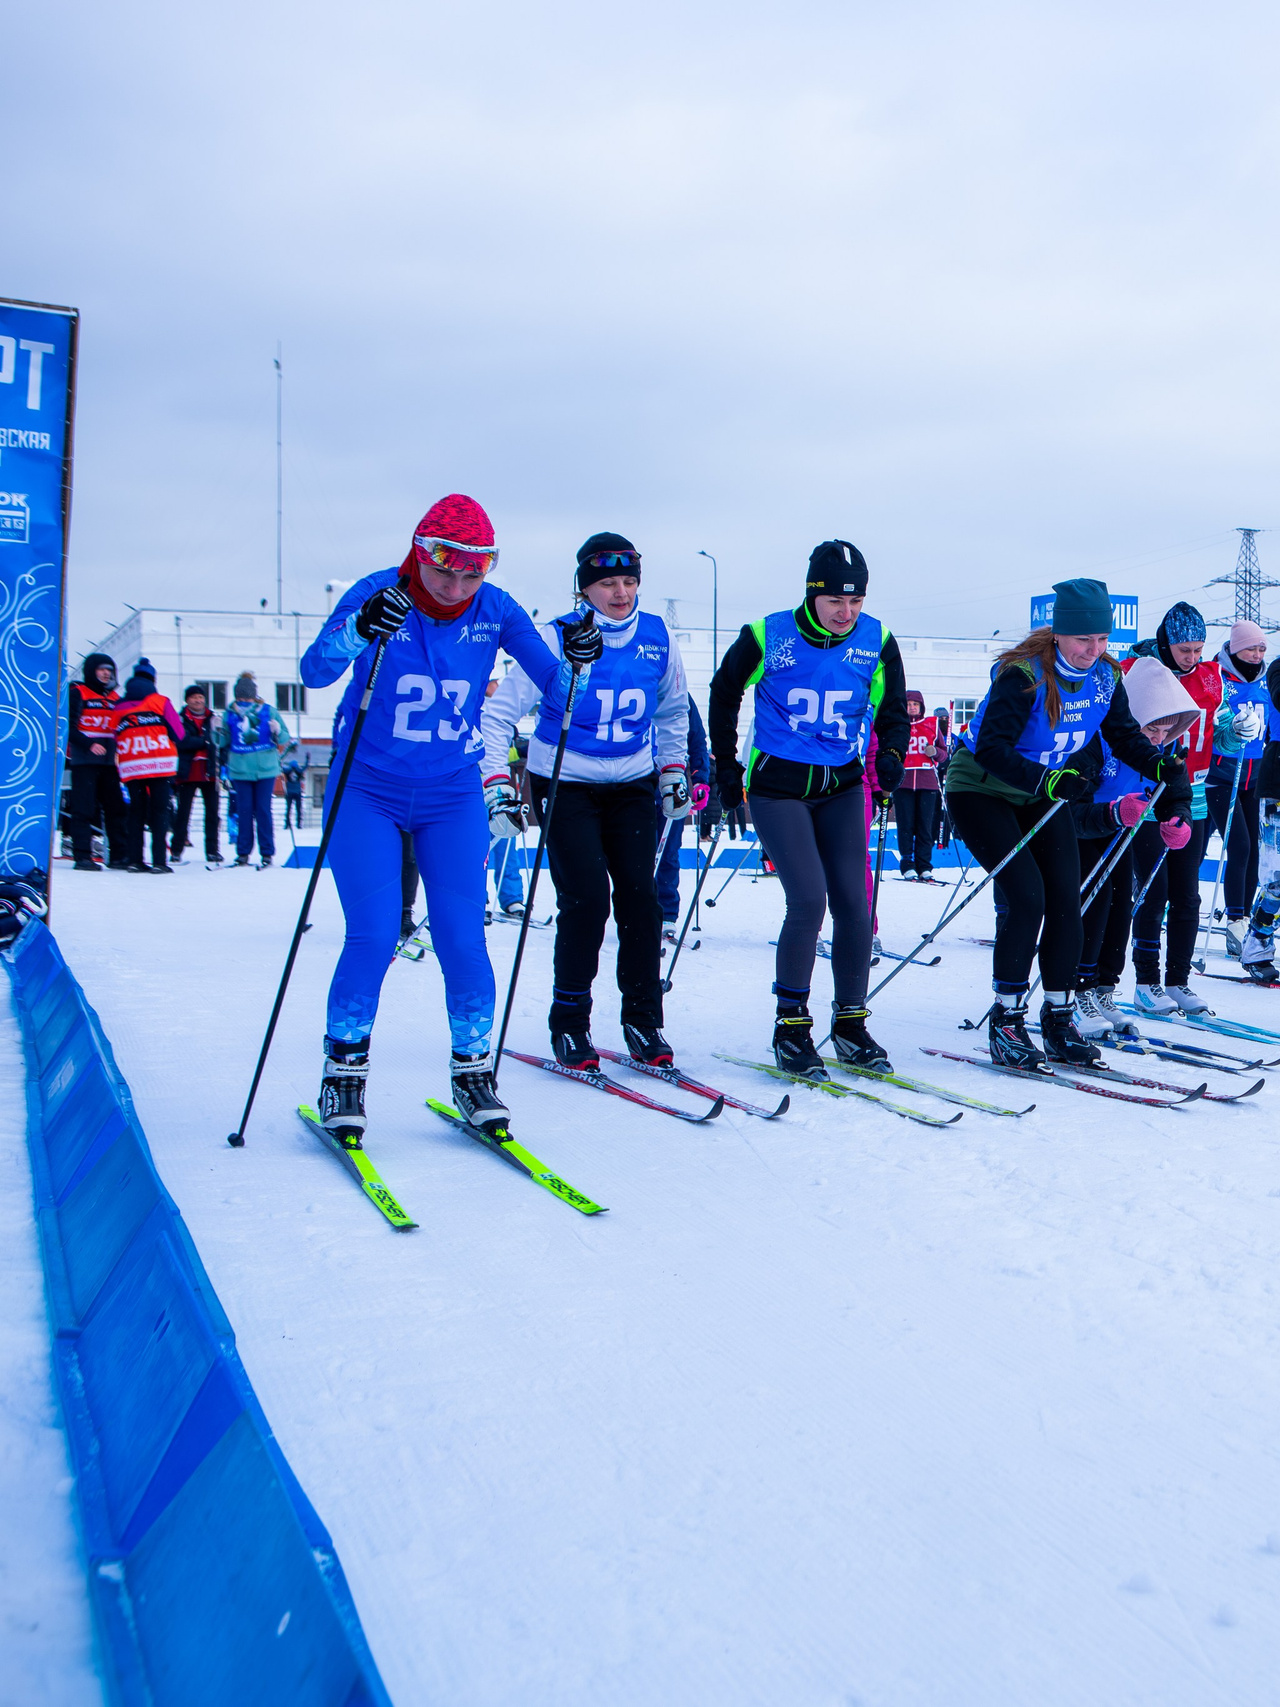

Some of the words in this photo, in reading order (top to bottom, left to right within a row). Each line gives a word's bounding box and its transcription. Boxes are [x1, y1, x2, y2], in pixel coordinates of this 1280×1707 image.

[369, 643, 386, 688] MADSHUS
[393, 673, 471, 743] 23
[569, 673, 580, 711] MADSHUS
[1064, 700, 1091, 711] ЛЫЖНЯ
[596, 688, 646, 742] 12
[787, 687, 853, 741] 25
[1038, 730, 1087, 766] 11
[543, 1062, 606, 1090] MADSHUS
[619, 1057, 679, 1086] MADSHUS
[860, 1068, 885, 1080] FISCHER
[373, 1188, 407, 1219] FISCHER
[547, 1177, 592, 1206] FISCHER
